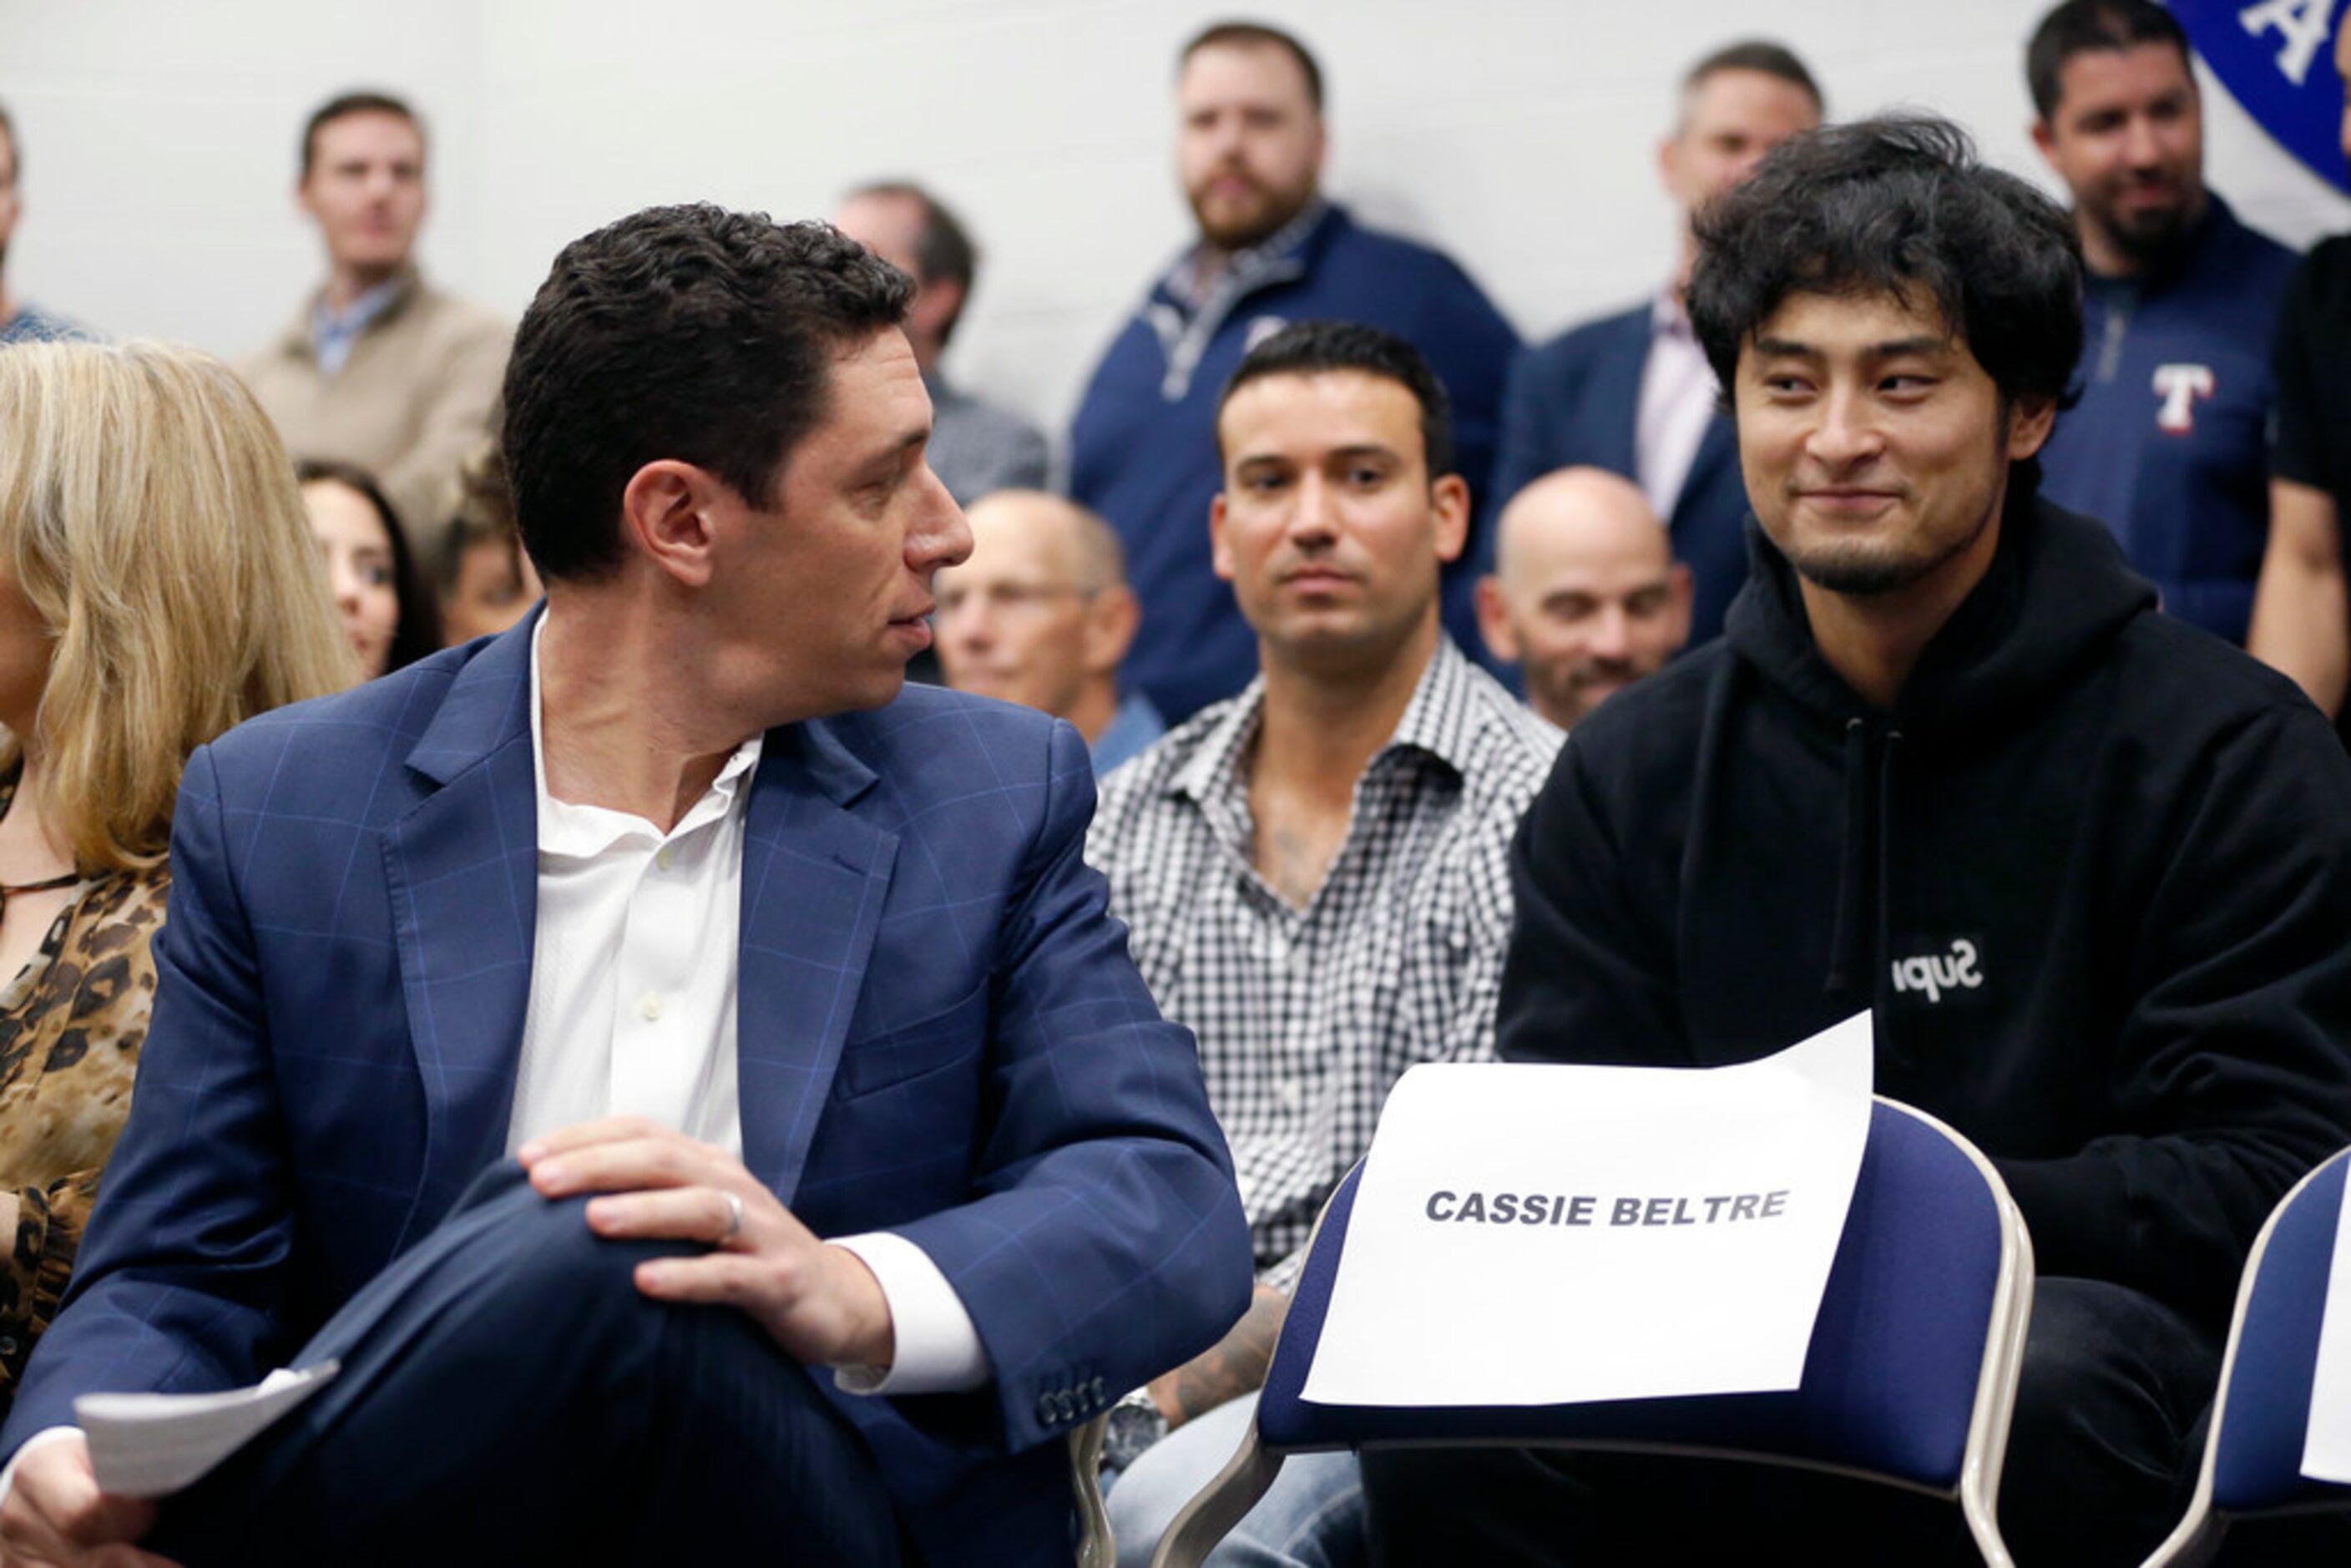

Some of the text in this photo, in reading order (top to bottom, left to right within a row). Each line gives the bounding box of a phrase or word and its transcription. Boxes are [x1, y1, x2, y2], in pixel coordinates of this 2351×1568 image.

[2152, 363, 2217, 437] T
[1425, 1189, 1790, 1227] CASSIE BELTRE
